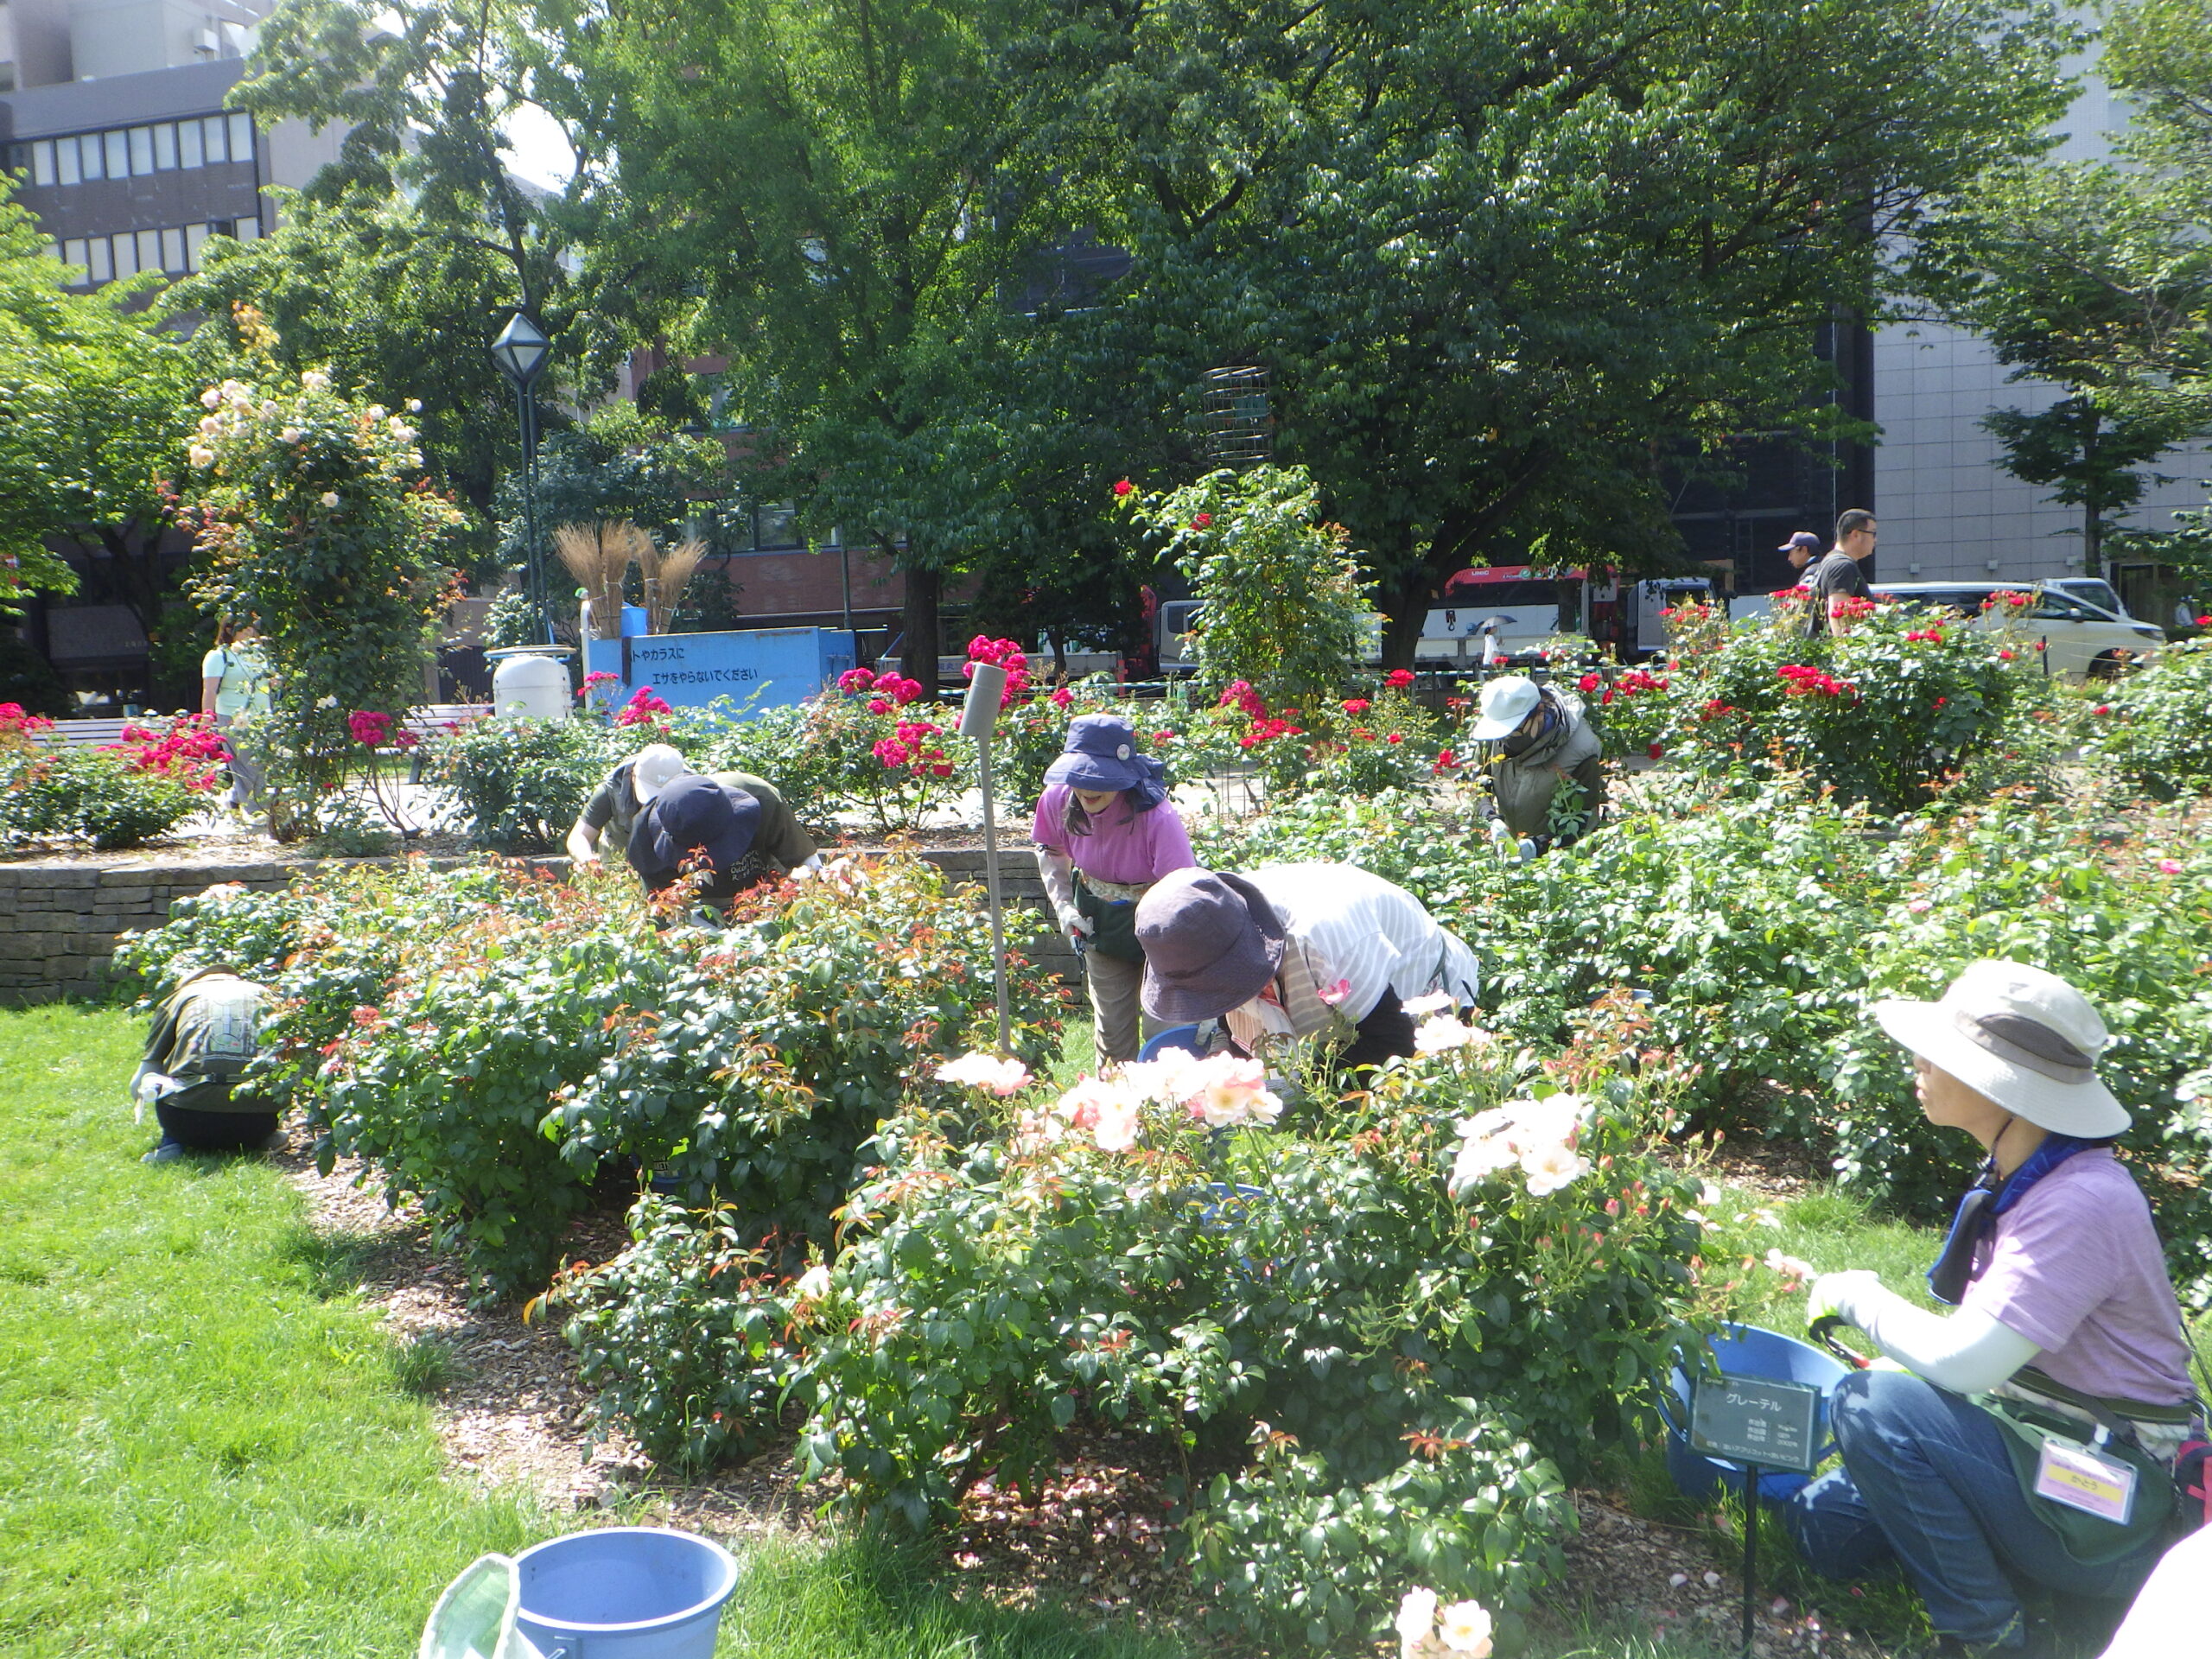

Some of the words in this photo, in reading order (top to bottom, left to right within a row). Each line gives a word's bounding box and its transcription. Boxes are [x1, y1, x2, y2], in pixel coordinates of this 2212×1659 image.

[632, 647, 685, 663] トやカラスに
[652, 668, 758, 685] エサをやらないでください
[1726, 1392, 1783, 1412] グレーテル
